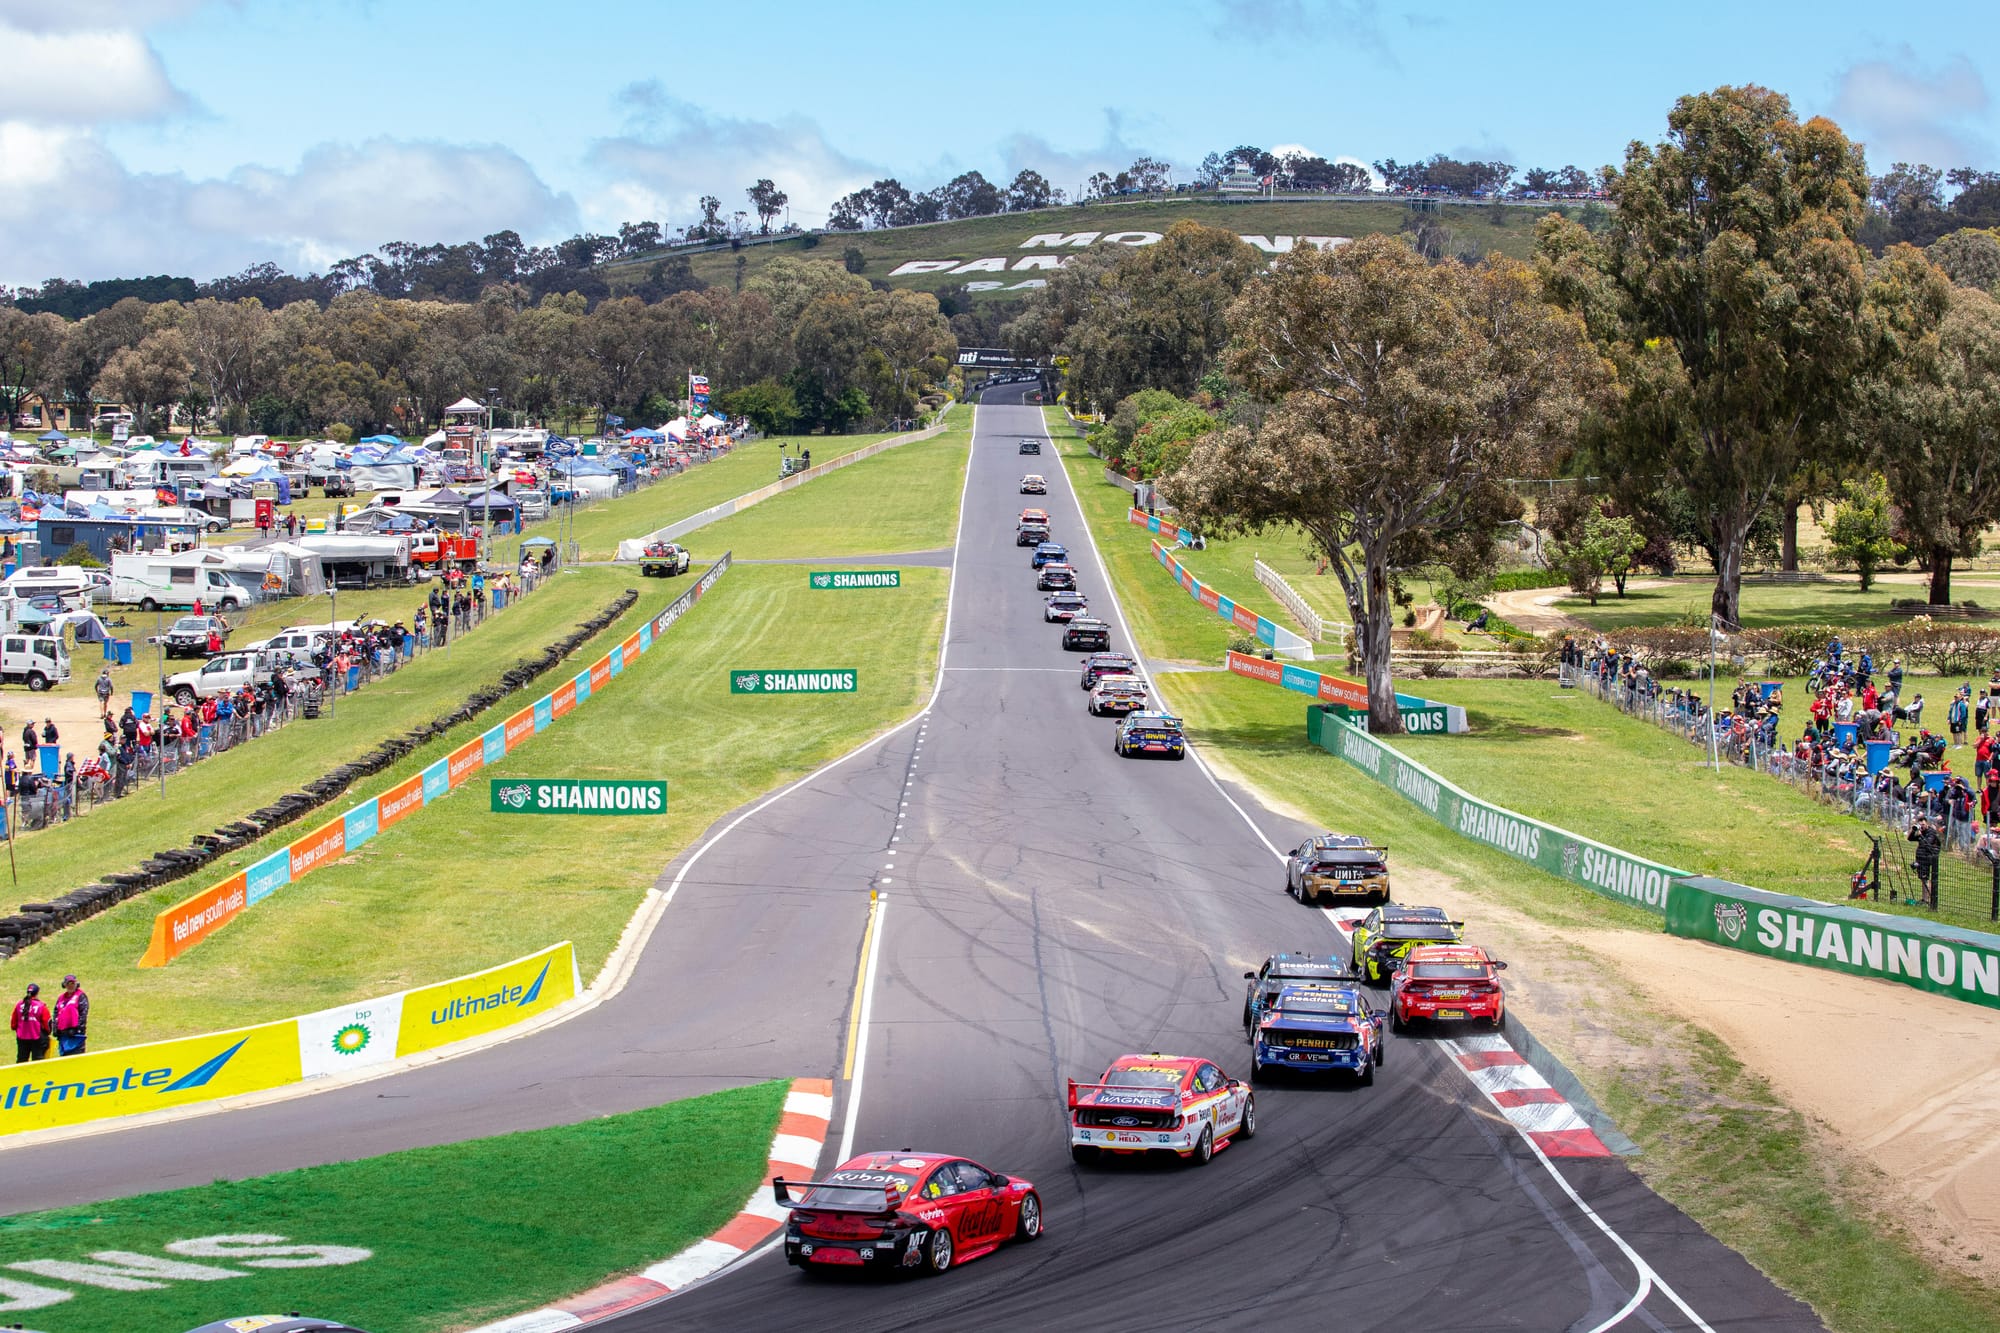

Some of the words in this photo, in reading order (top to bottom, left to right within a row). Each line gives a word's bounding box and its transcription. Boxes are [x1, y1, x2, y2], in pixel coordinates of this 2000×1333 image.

[1018, 230, 1354, 252] MONT
[834, 574, 897, 587] SHANNONS
[1232, 657, 1242, 670] feel
[1242, 660, 1252, 673] new
[1252, 661, 1266, 676] south
[764, 673, 853, 691] SHANNONS
[1320, 680, 1331, 694] feel
[1331, 685, 1343, 697] new
[1343, 687, 1359, 702] south
[1344, 730, 1381, 775] SHANNONS
[537, 785, 661, 810] SHANNONS
[1396, 763, 1440, 813] SHANNONS
[1460, 801, 1540, 860] SHANNONS
[292, 850, 303, 874] feel
[303, 848, 315, 868] new
[315, 836, 330, 860] south
[329, 829, 344, 850] wales
[1582, 846, 1670, 908] SHANNO
[173, 914, 189, 943] feel
[189, 910, 206, 935] new
[205, 895, 225, 925] south
[224, 887, 243, 913] wales
[1757, 909, 2000, 996] SHANNON
[355, 1009, 372, 1020] bp
[431, 984, 523, 1025] ultimate
[1296, 1039, 1336, 1048] PENRITE
[0, 1067, 172, 1110] ltimate
[1100, 1095, 1163, 1106] WAGNER
[832, 1172, 906, 1185] Kubota
[909, 1230, 928, 1247] M7
